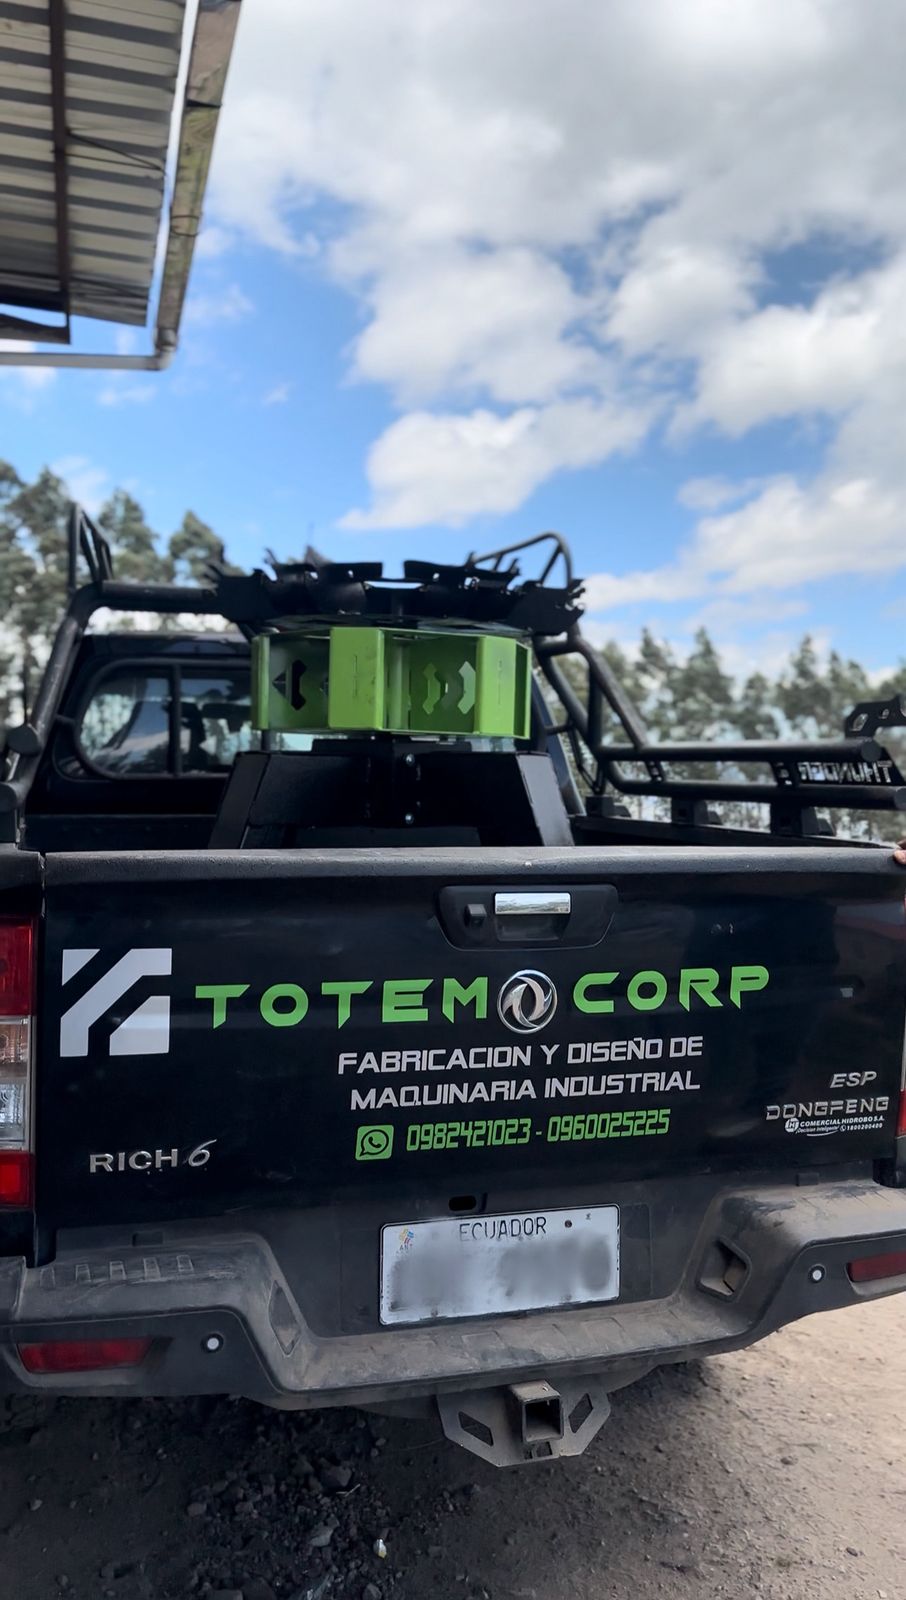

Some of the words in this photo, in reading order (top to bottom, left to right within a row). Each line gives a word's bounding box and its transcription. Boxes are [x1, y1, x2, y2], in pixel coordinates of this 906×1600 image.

[194, 976, 489, 1029] TOTEM
[572, 965, 770, 1012] CORP
[338, 1045, 532, 1075] FABRICACION
[540, 1043, 560, 1064] Y
[567, 1036, 663, 1065] DISEÑO
[669, 1035, 703, 1058] DE
[350, 1079, 537, 1110] MAQUINARIA
[544, 1071, 701, 1098] INDUSTRIAL
[829, 1071, 877, 1088] ESP
[766, 1096, 890, 1120] DONGFENG
[800, 1119, 840, 1127] COMERCIAL
[841, 1116, 873, 1124] HIDROBO
[406, 1117, 530, 1152] 0982421023
[547, 1109, 671, 1142] 0960025225
[89, 1148, 179, 1173] RICH
[183, 1139, 217, 1168] 6
[459, 1216, 547, 1242] ECUADOR
